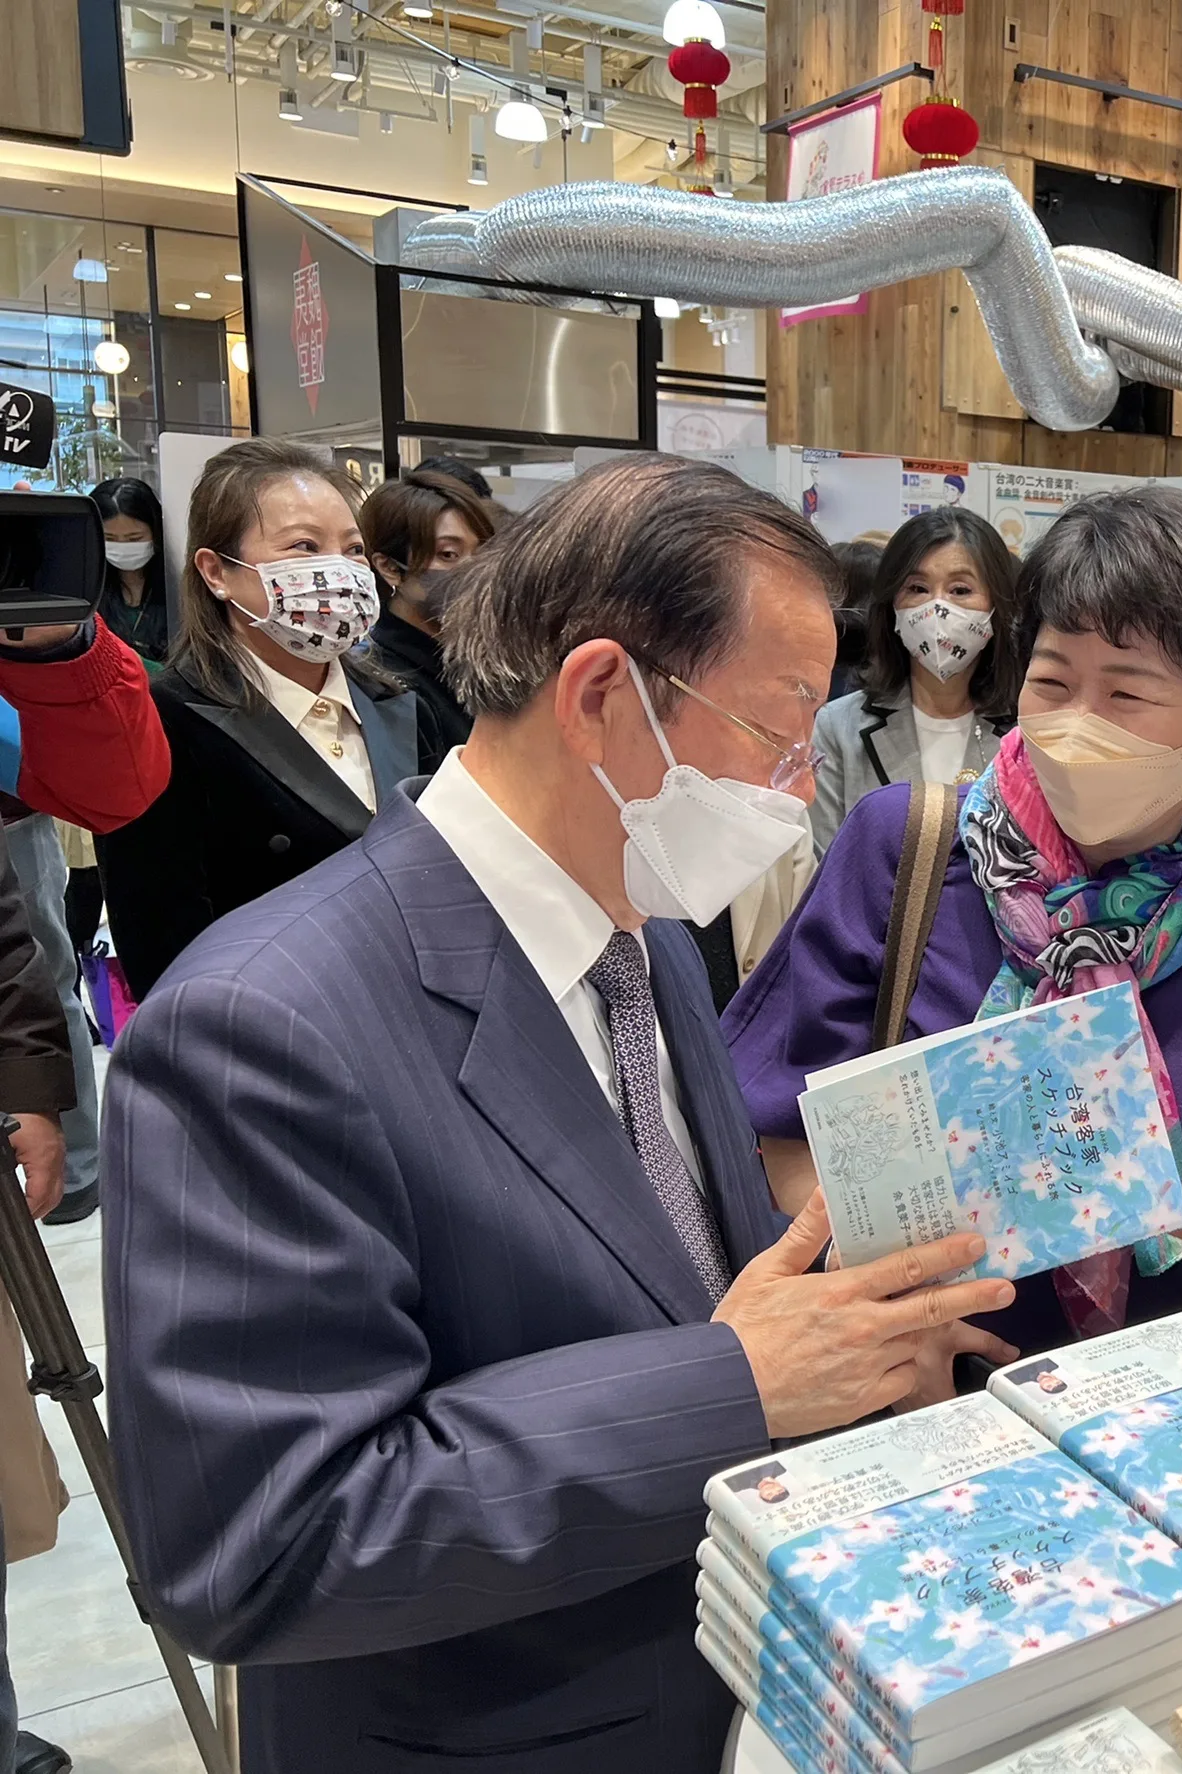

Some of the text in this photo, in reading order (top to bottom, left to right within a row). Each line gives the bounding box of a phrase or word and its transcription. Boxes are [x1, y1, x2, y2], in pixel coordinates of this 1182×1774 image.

[1037, 1068, 1083, 1195] スケッチブック
[1066, 1083, 1101, 1167] 台湾客家
[907, 1529, 1082, 1601] スケッチブック
[953, 1555, 1070, 1608] 台湾客家
